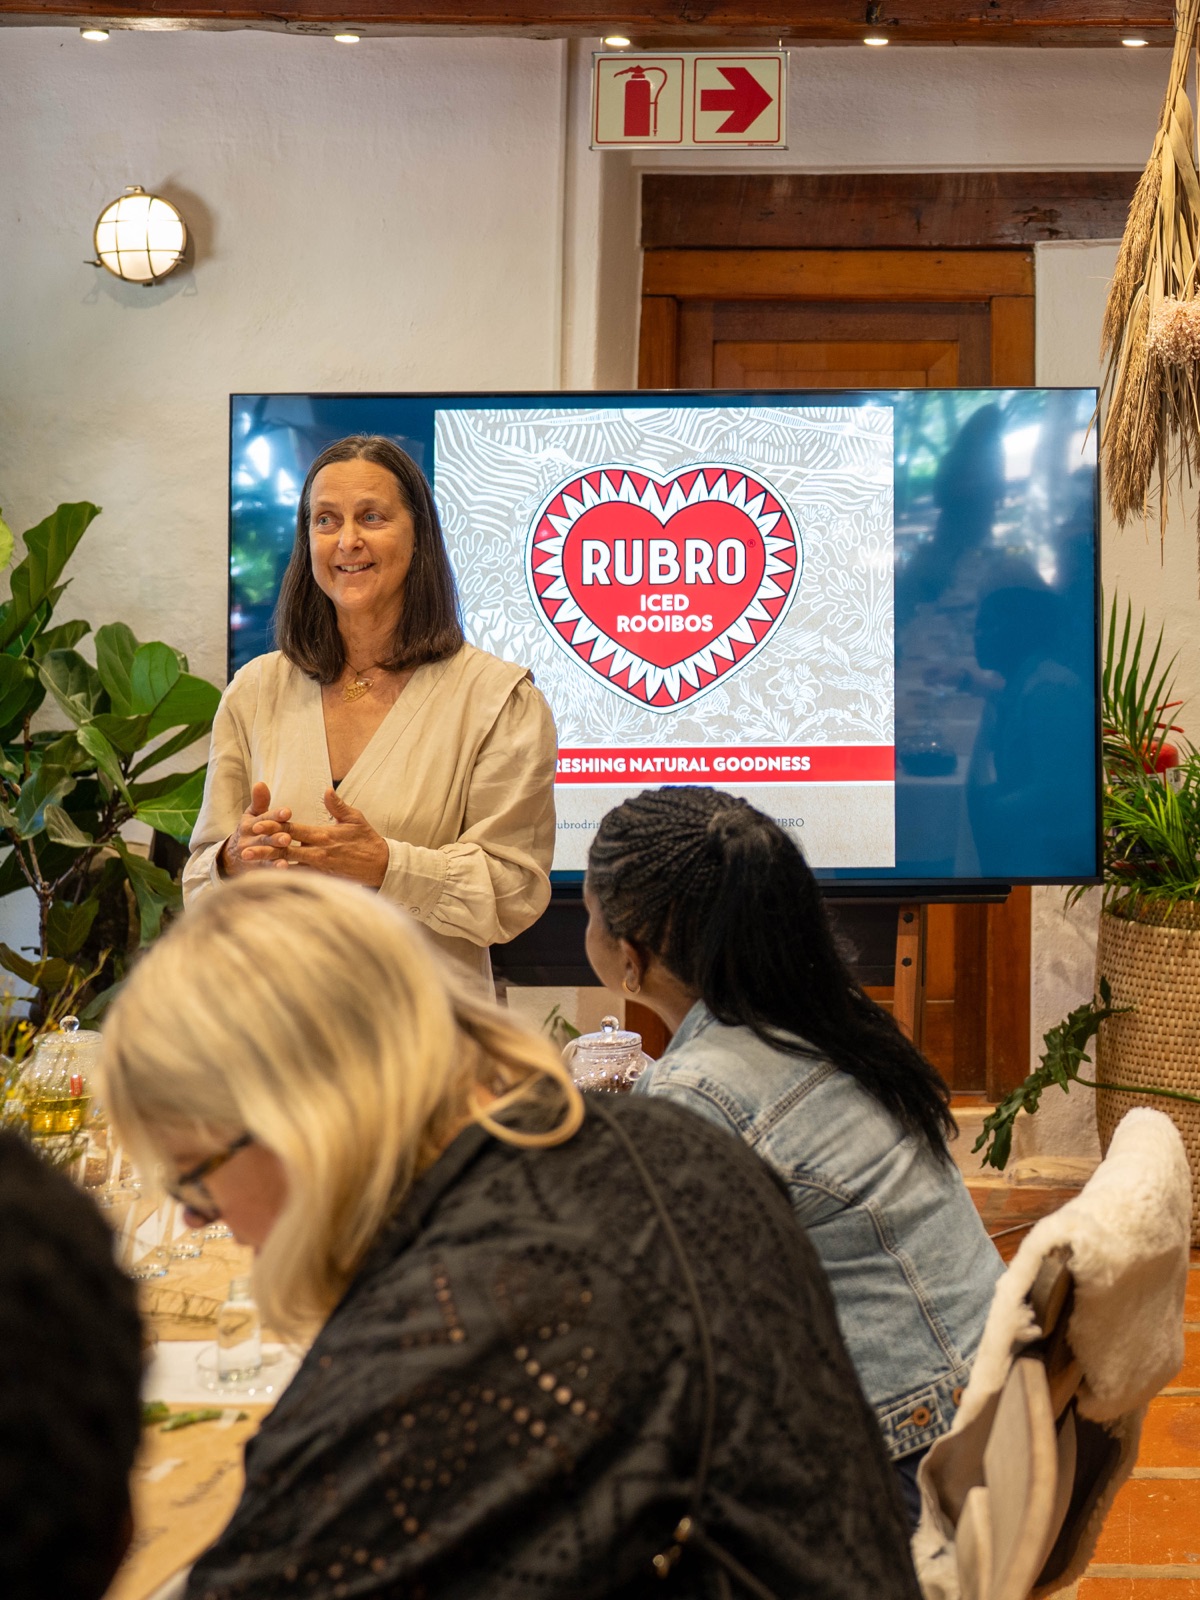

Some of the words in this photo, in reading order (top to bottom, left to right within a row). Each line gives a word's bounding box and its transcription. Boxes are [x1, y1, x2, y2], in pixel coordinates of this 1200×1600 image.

[582, 538, 746, 586] RUBRO
[640, 594, 690, 611] ICED
[616, 614, 714, 633] ROOIBOS
[629, 757, 710, 772] NATURAL
[712, 756, 811, 772] GOODNESS
